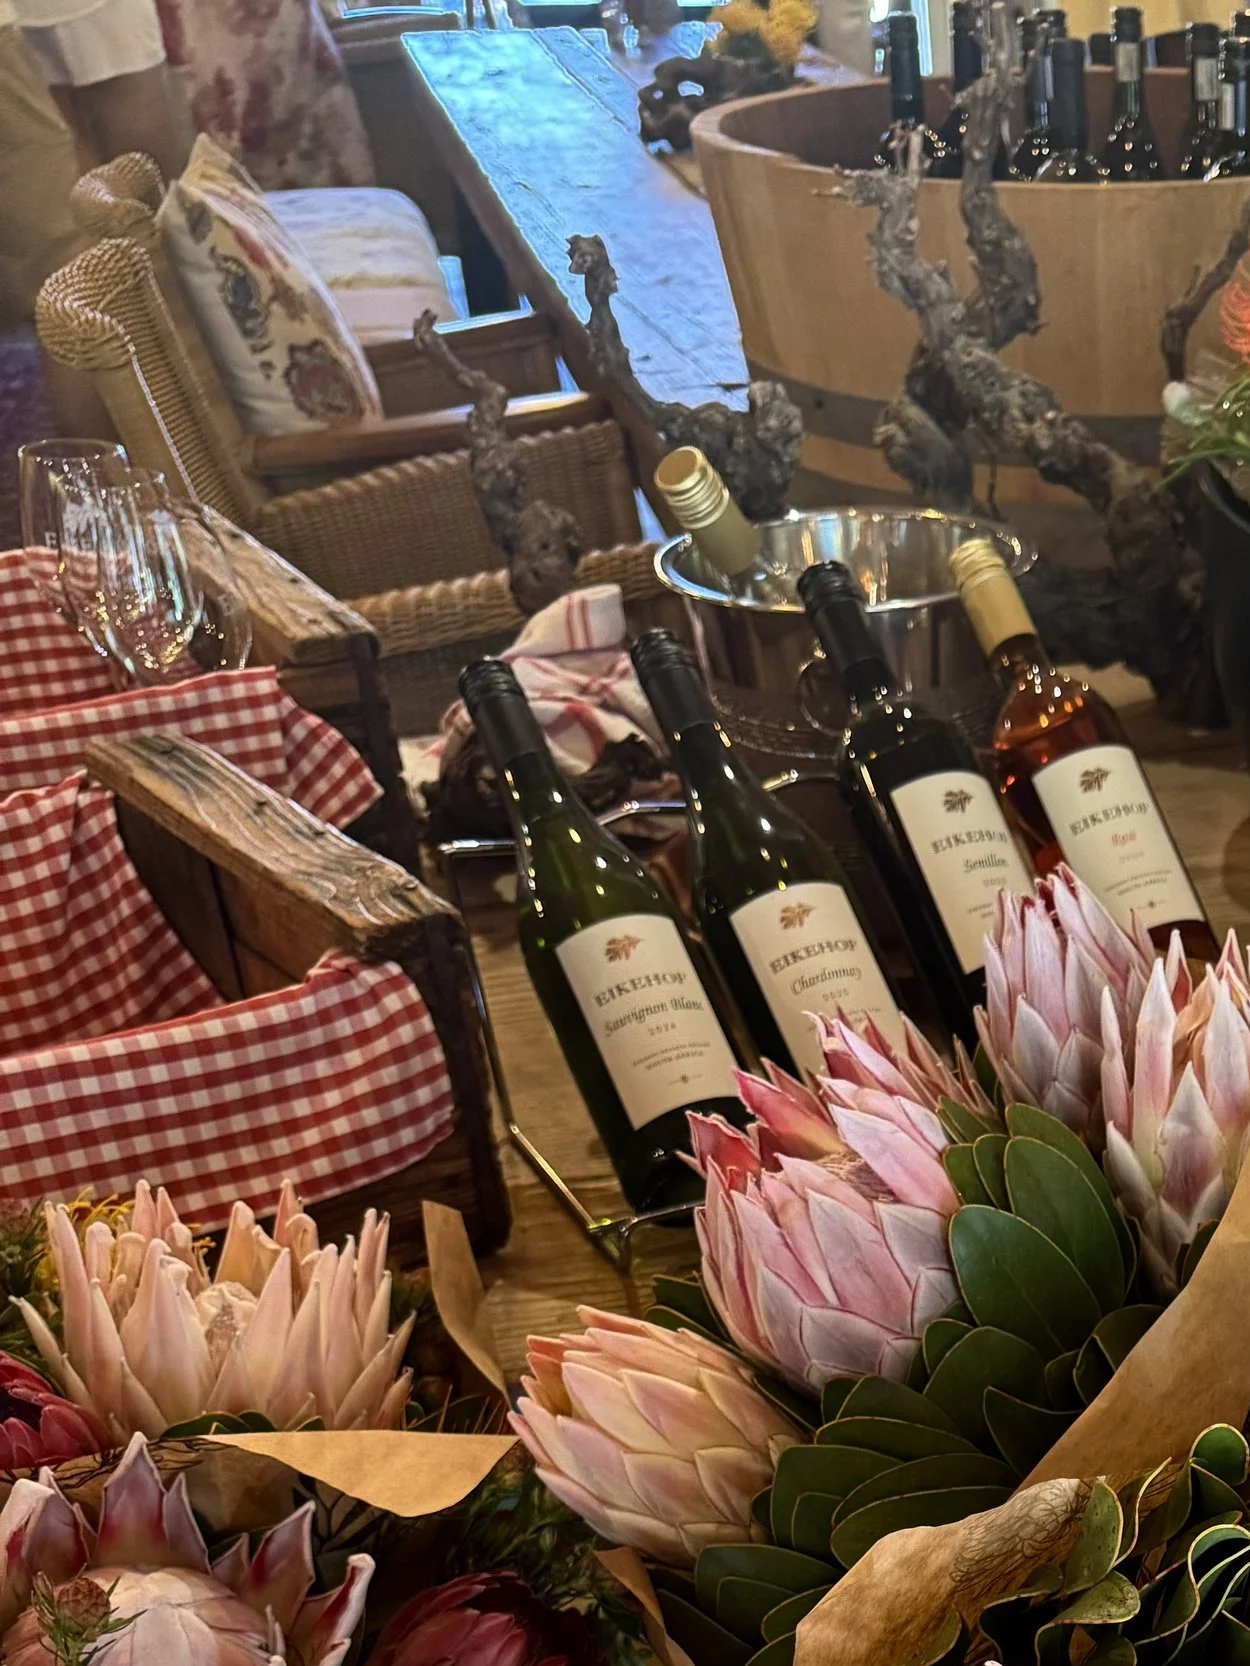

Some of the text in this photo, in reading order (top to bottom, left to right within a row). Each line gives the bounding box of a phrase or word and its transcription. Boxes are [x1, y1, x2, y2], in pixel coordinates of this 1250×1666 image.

[789, 965, 862, 996] Chardonnay
[604, 996, 705, 1037] Sauvignon Blanc
